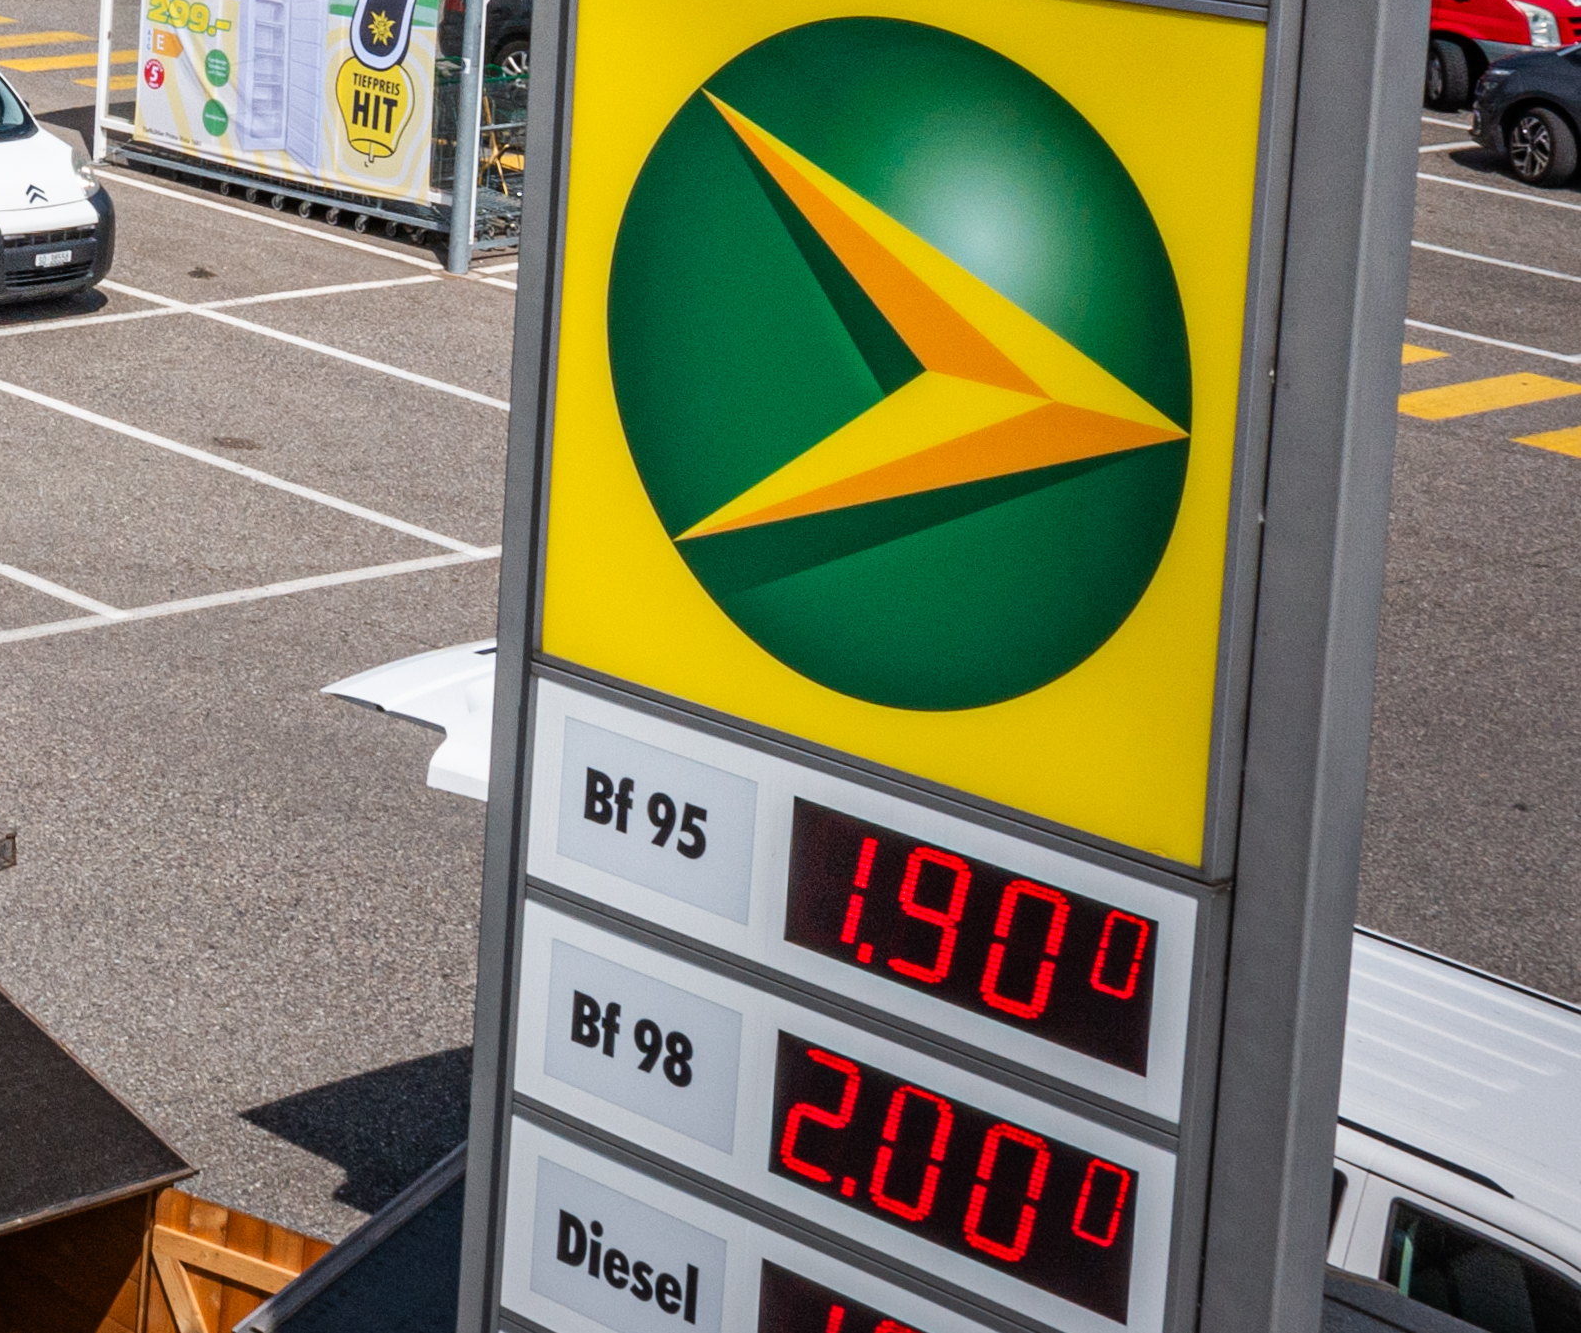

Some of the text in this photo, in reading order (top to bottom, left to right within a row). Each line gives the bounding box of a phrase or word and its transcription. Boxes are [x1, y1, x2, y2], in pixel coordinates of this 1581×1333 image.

[352, 89, 398, 134] HIT
[353, 72, 400, 96] TIEFPREIS
[584, 766, 708, 860] Bf 95
[570, 990, 694, 1088] Bf 98
[556, 1208, 699, 1326] Diesel
